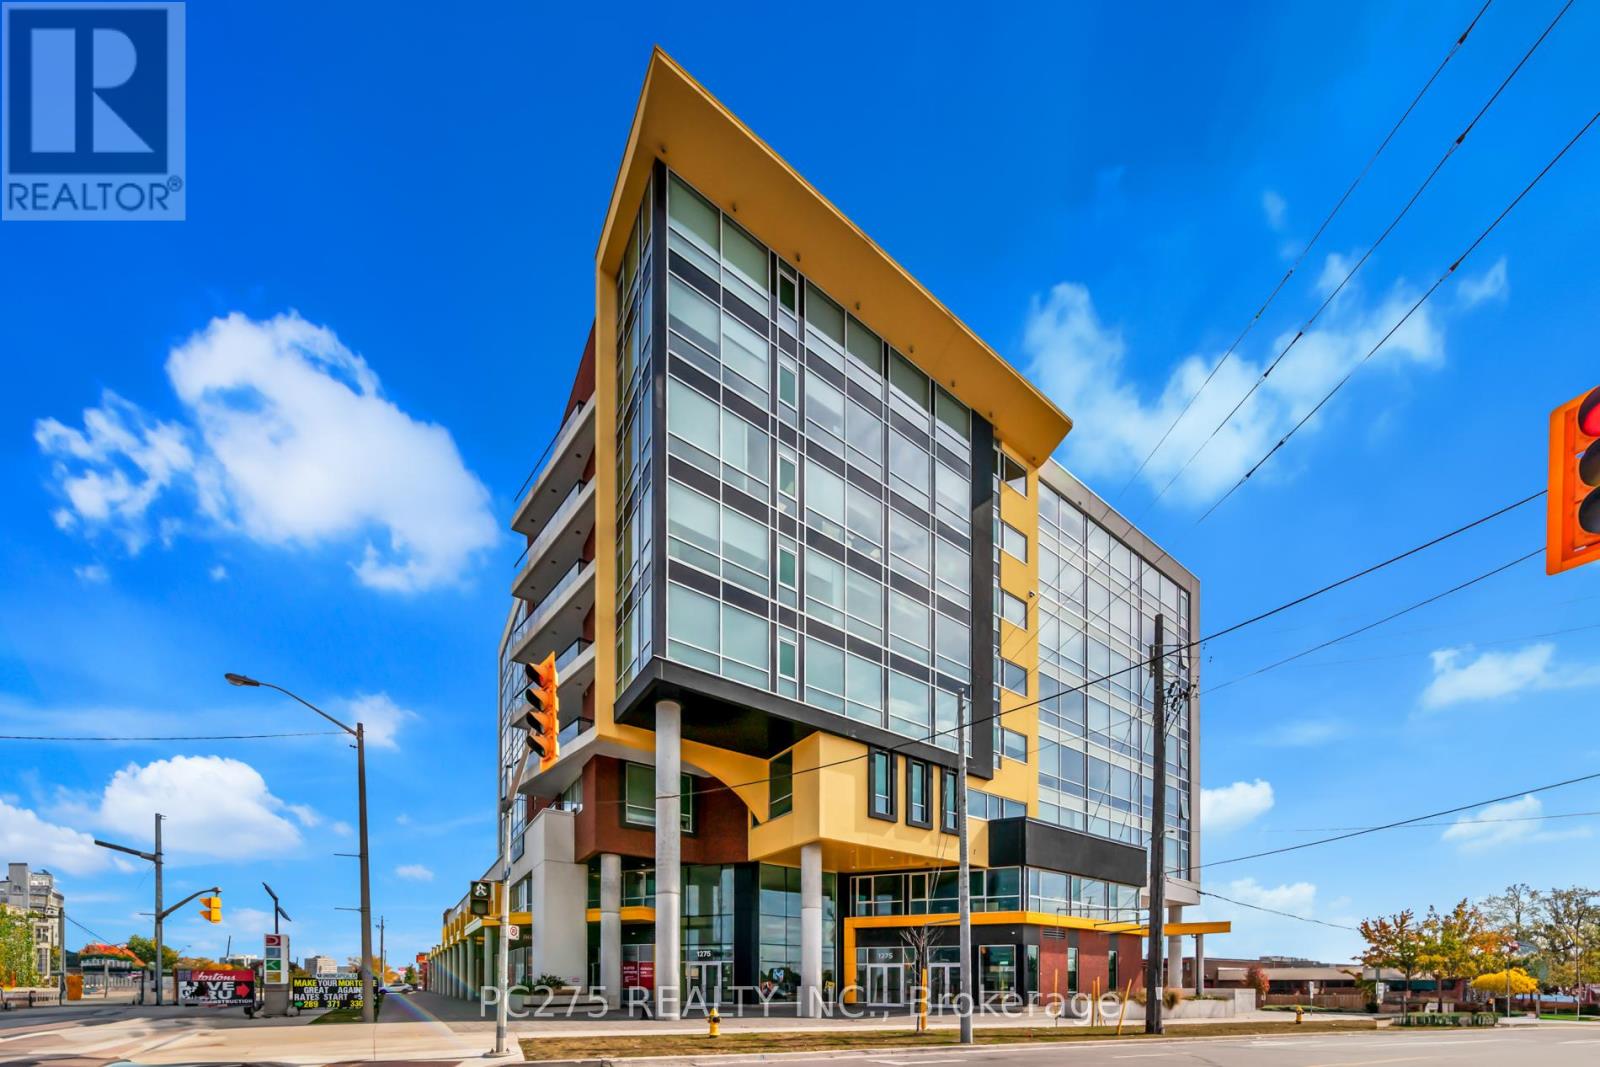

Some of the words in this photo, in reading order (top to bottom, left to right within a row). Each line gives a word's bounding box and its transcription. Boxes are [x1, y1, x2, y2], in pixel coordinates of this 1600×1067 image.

[294, 979, 316, 987] MAKE
[318, 979, 337, 987] YOUR
[294, 993, 320, 1001] RATES
[323, 993, 348, 1001] START
